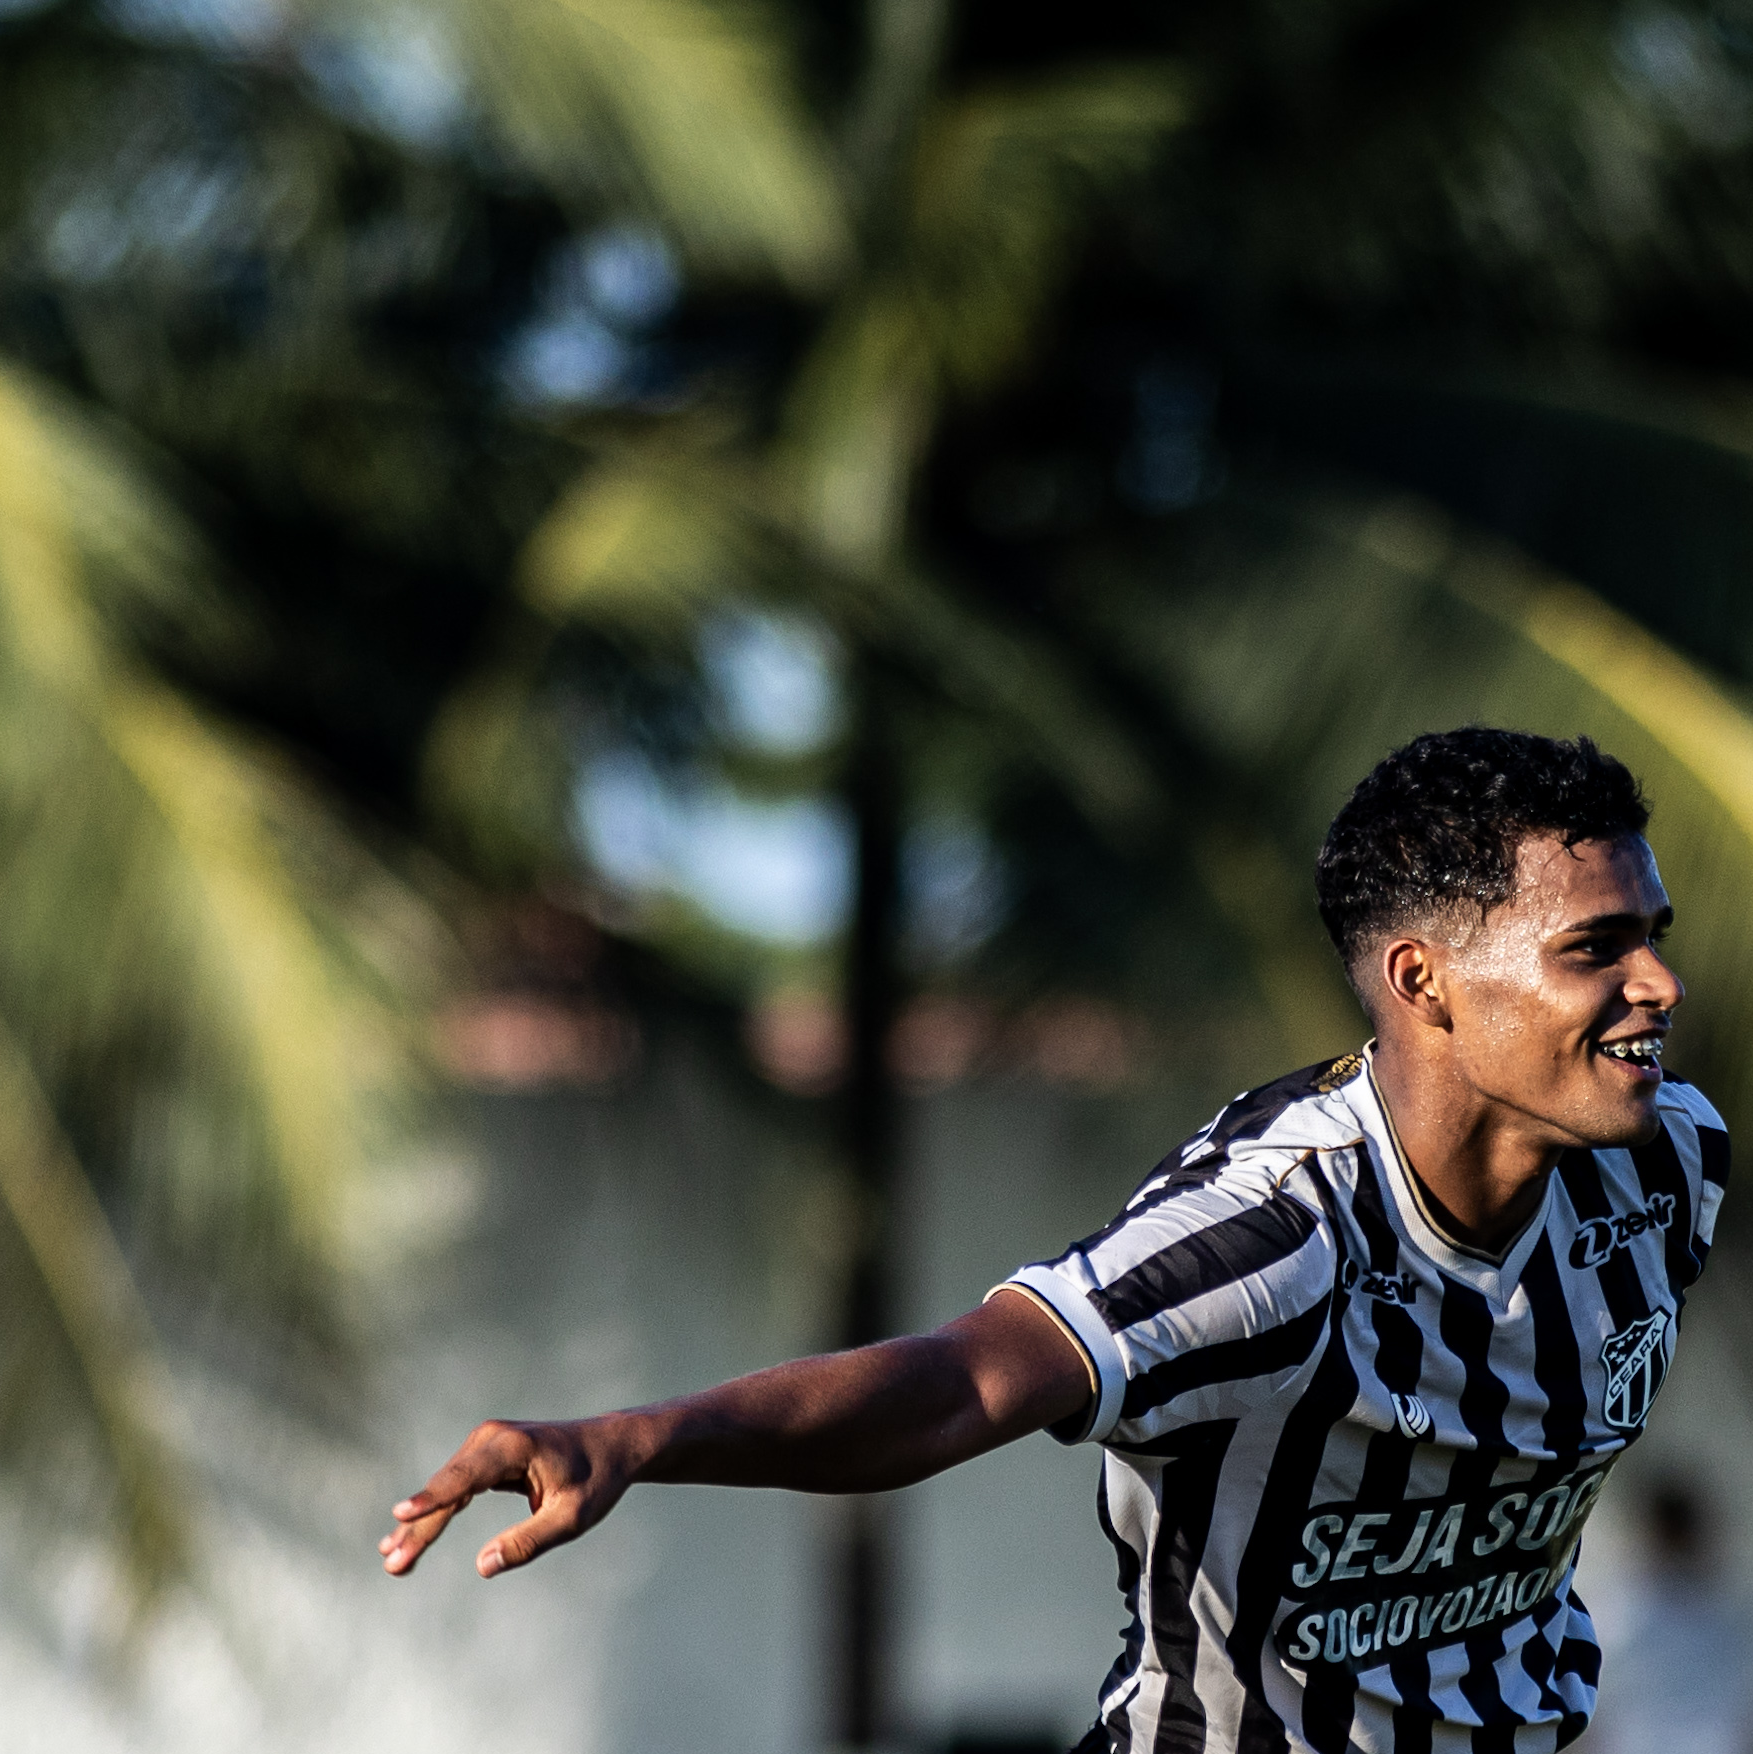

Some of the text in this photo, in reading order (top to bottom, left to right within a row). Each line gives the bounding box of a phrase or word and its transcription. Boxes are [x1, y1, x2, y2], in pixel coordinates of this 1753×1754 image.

[1292, 1471, 1605, 1588] SEJA SÓC
[1289, 1567, 1551, 1663] SOCIOVOZAO
